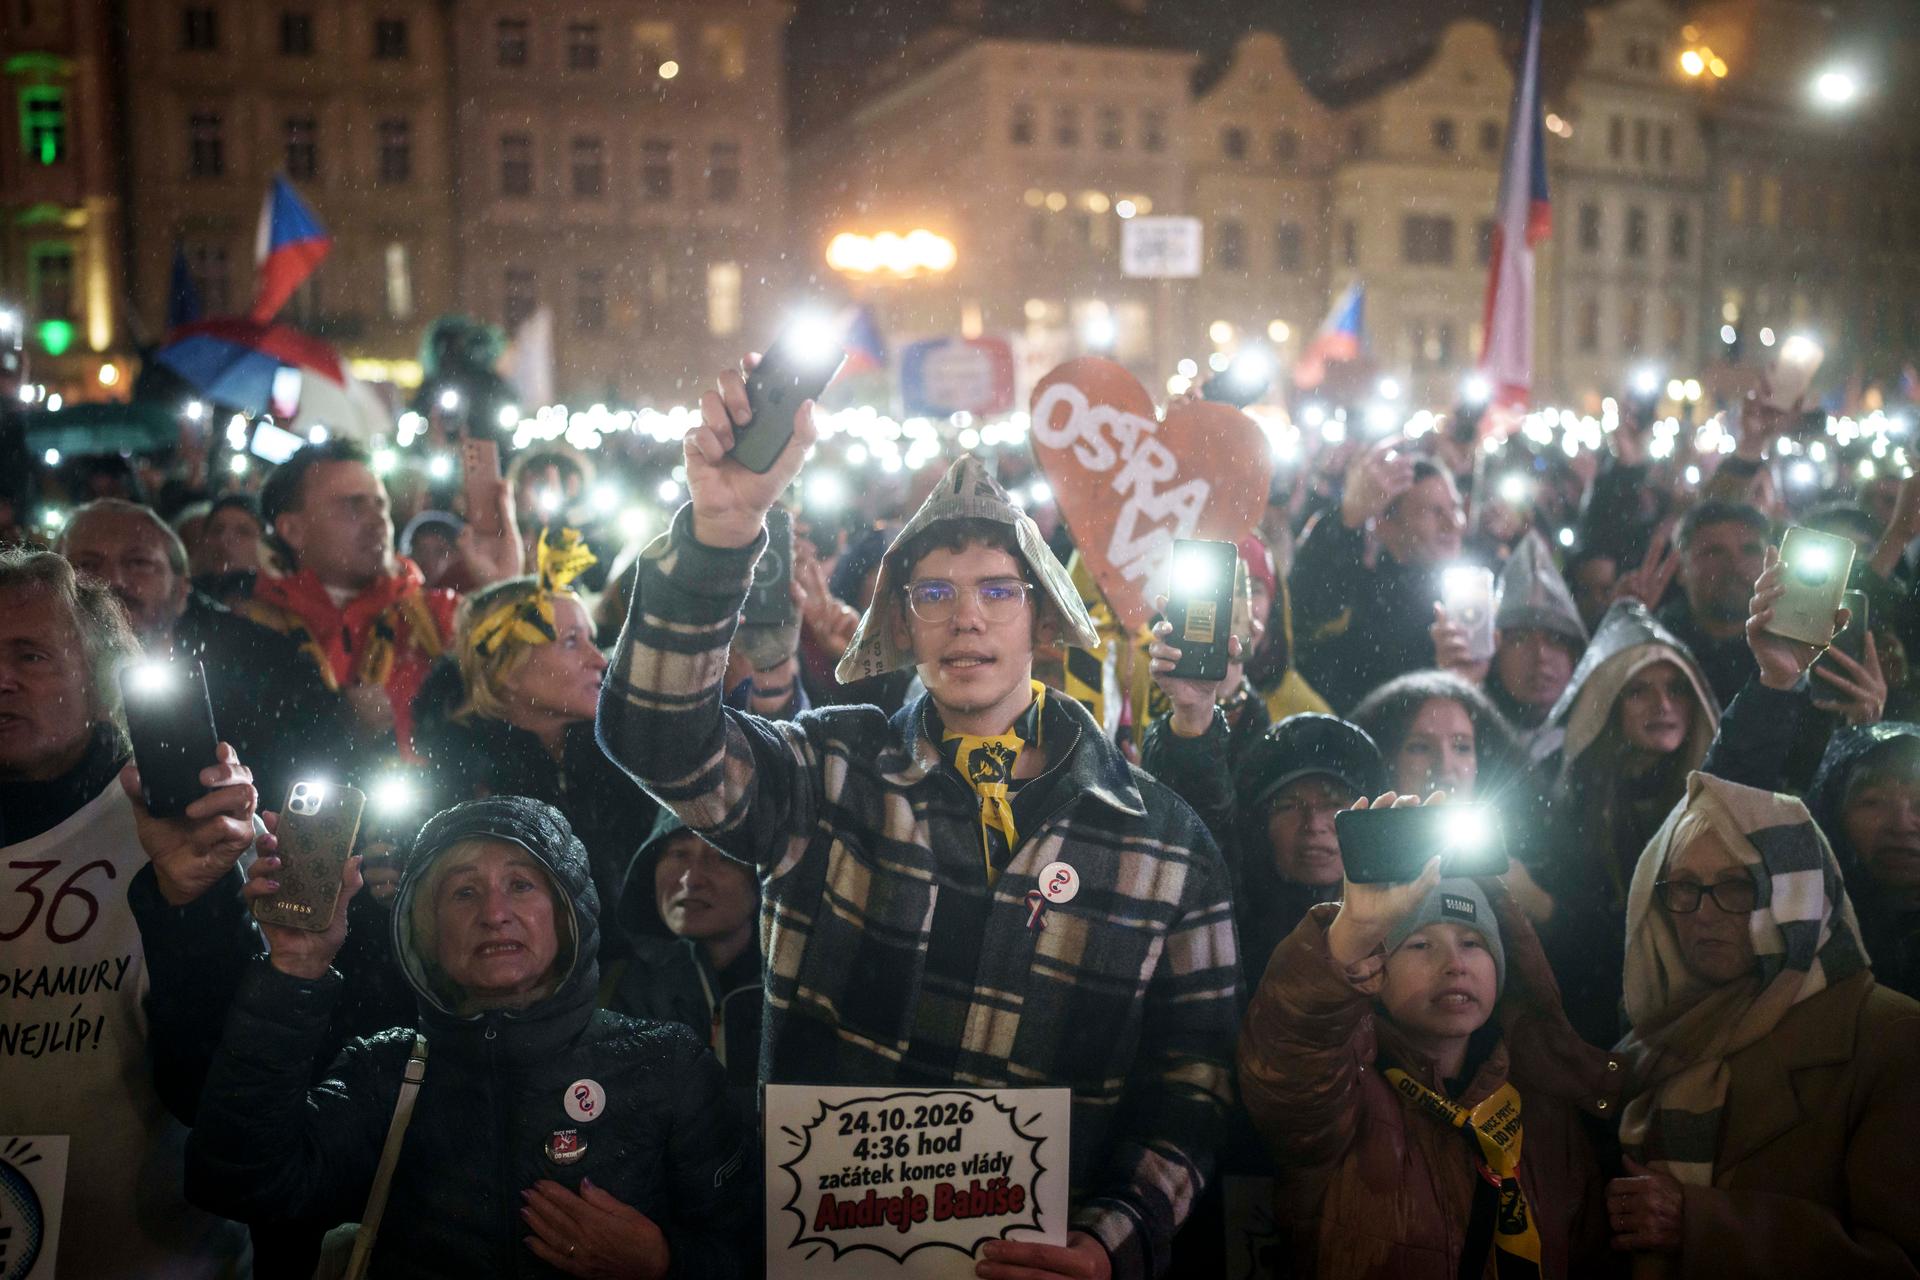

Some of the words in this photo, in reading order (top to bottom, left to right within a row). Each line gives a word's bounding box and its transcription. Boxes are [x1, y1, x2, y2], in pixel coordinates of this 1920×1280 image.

[277, 901, 312, 913] GUESS
[0, 1003, 104, 1059] NEJLÍP!
[1399, 1078, 1420, 1097] OD
[838, 1101, 974, 1136] 24.10.2026
[853, 1133, 910, 1161] 4:36
[917, 1128, 962, 1156] hod
[1492, 1131, 1509, 1145] OD
[818, 1163, 894, 1190] začátek
[900, 1158, 956, 1182] konce
[961, 1151, 1013, 1177] vlády
[813, 1187, 928, 1233] Andreje
[933, 1176, 1026, 1222] Babiše
